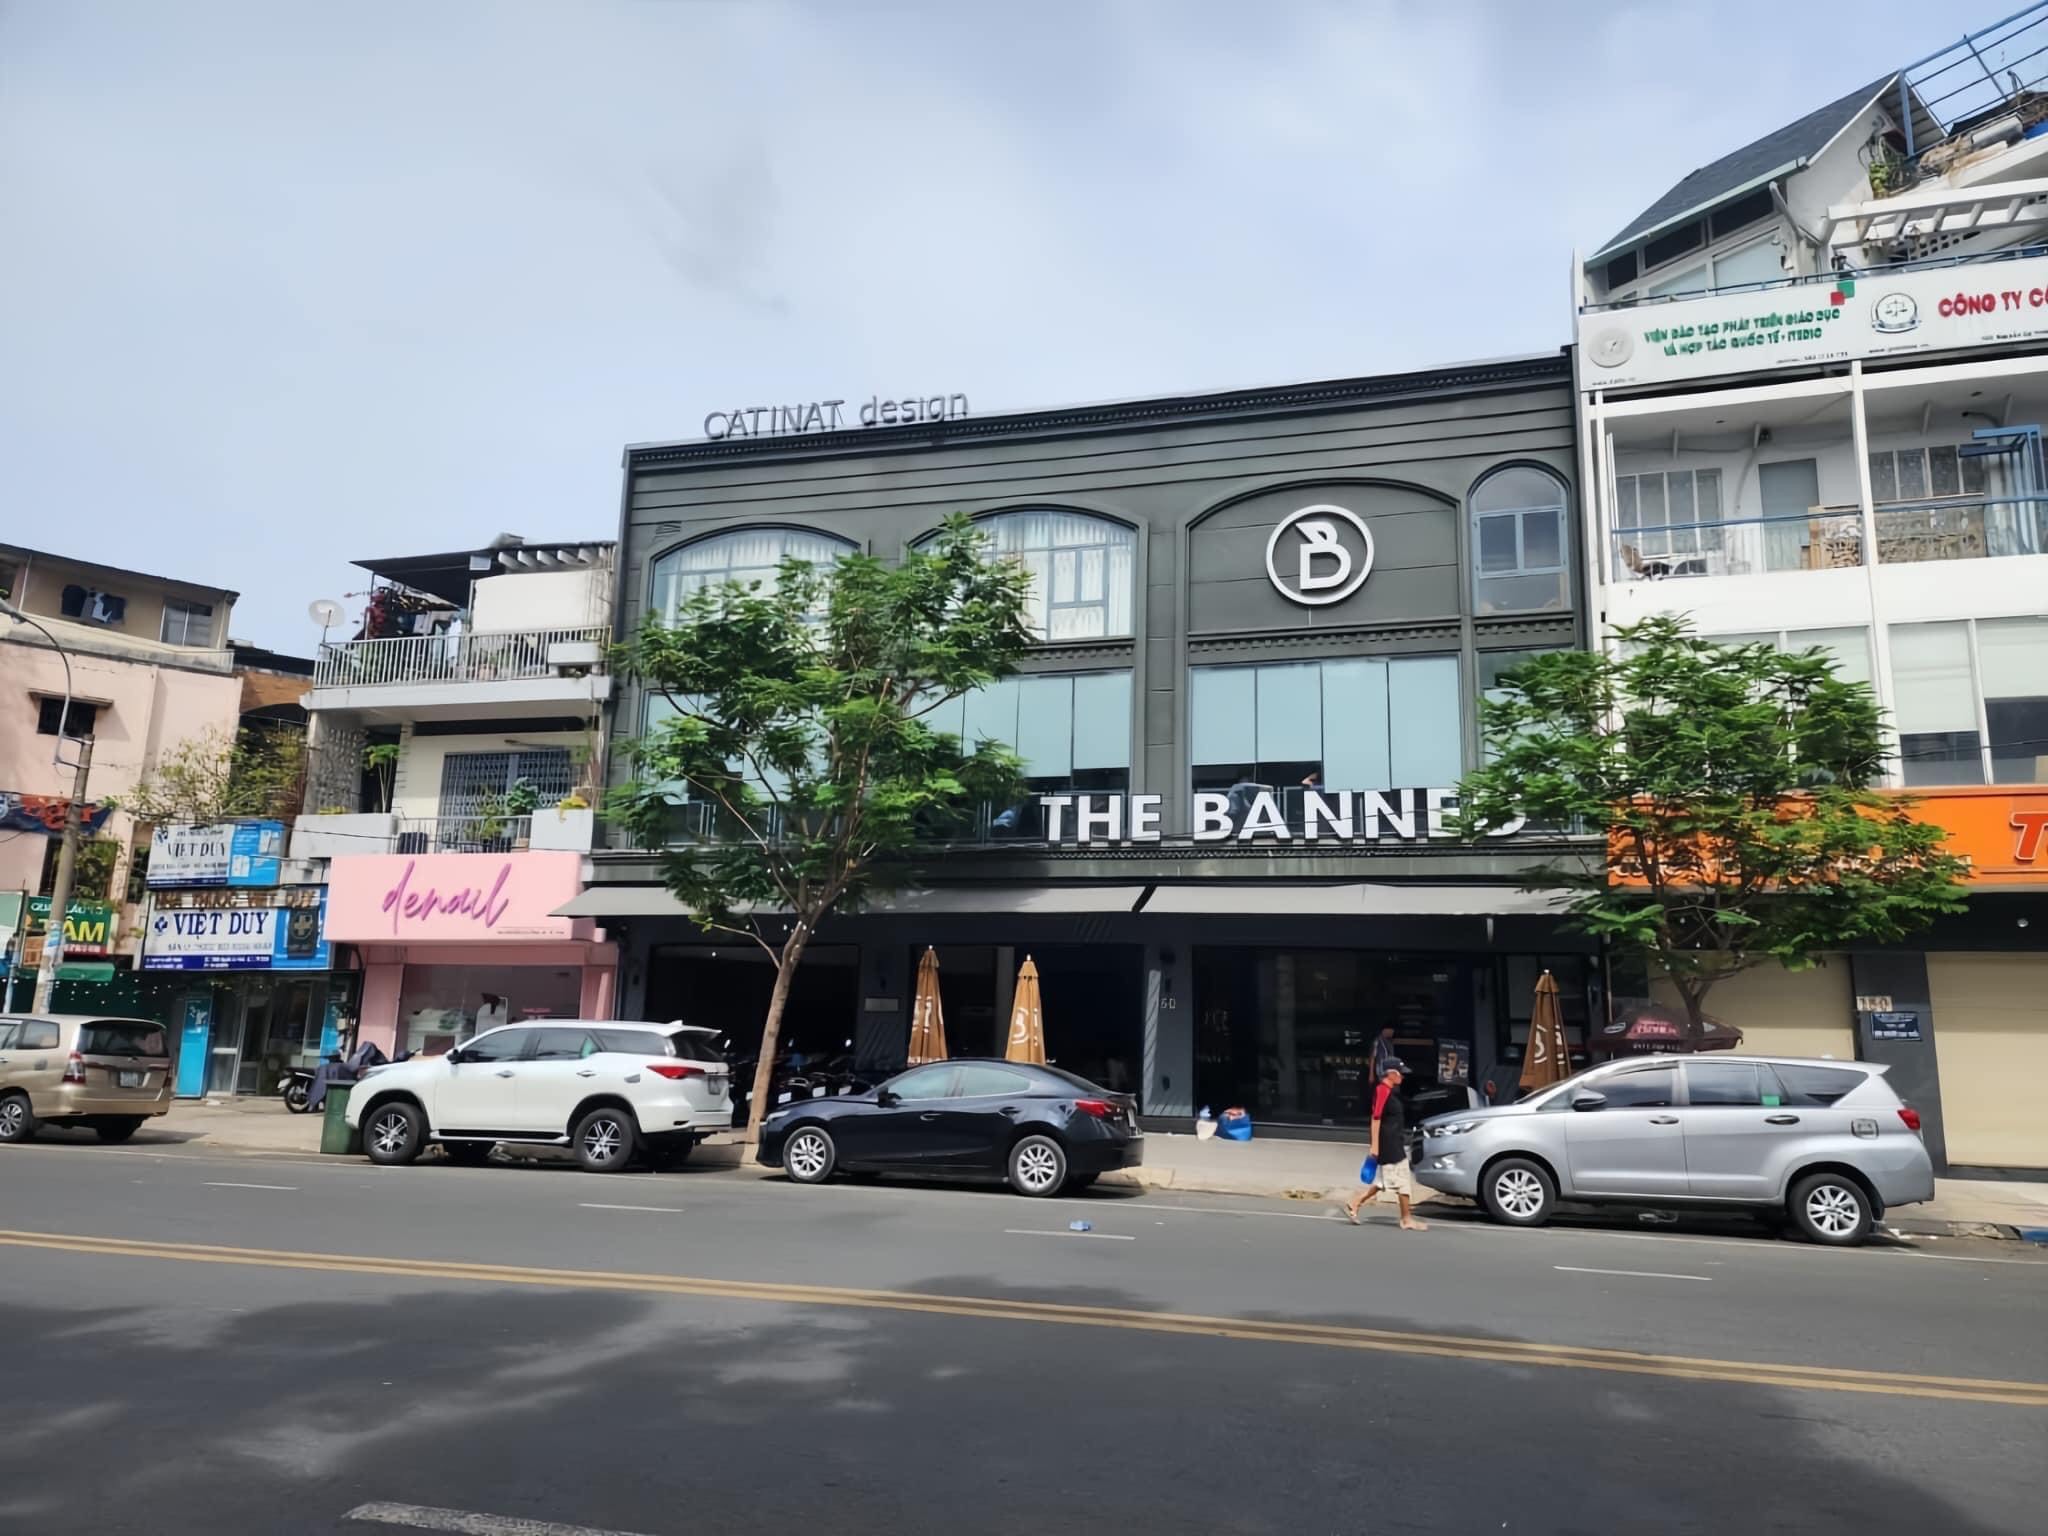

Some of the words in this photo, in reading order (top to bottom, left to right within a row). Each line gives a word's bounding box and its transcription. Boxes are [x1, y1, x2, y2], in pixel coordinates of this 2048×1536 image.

[1938, 291, 1997, 318] CÔNG
[2001, 290, 2022, 311] TY
[2029, 283, 2048, 308] C
[704, 399, 845, 440] CATINAT
[859, 392, 970, 426] design
[1040, 794, 1163, 842] THE
[2010, 811, 2048, 861] T
[228, 911, 269, 936] DUY
